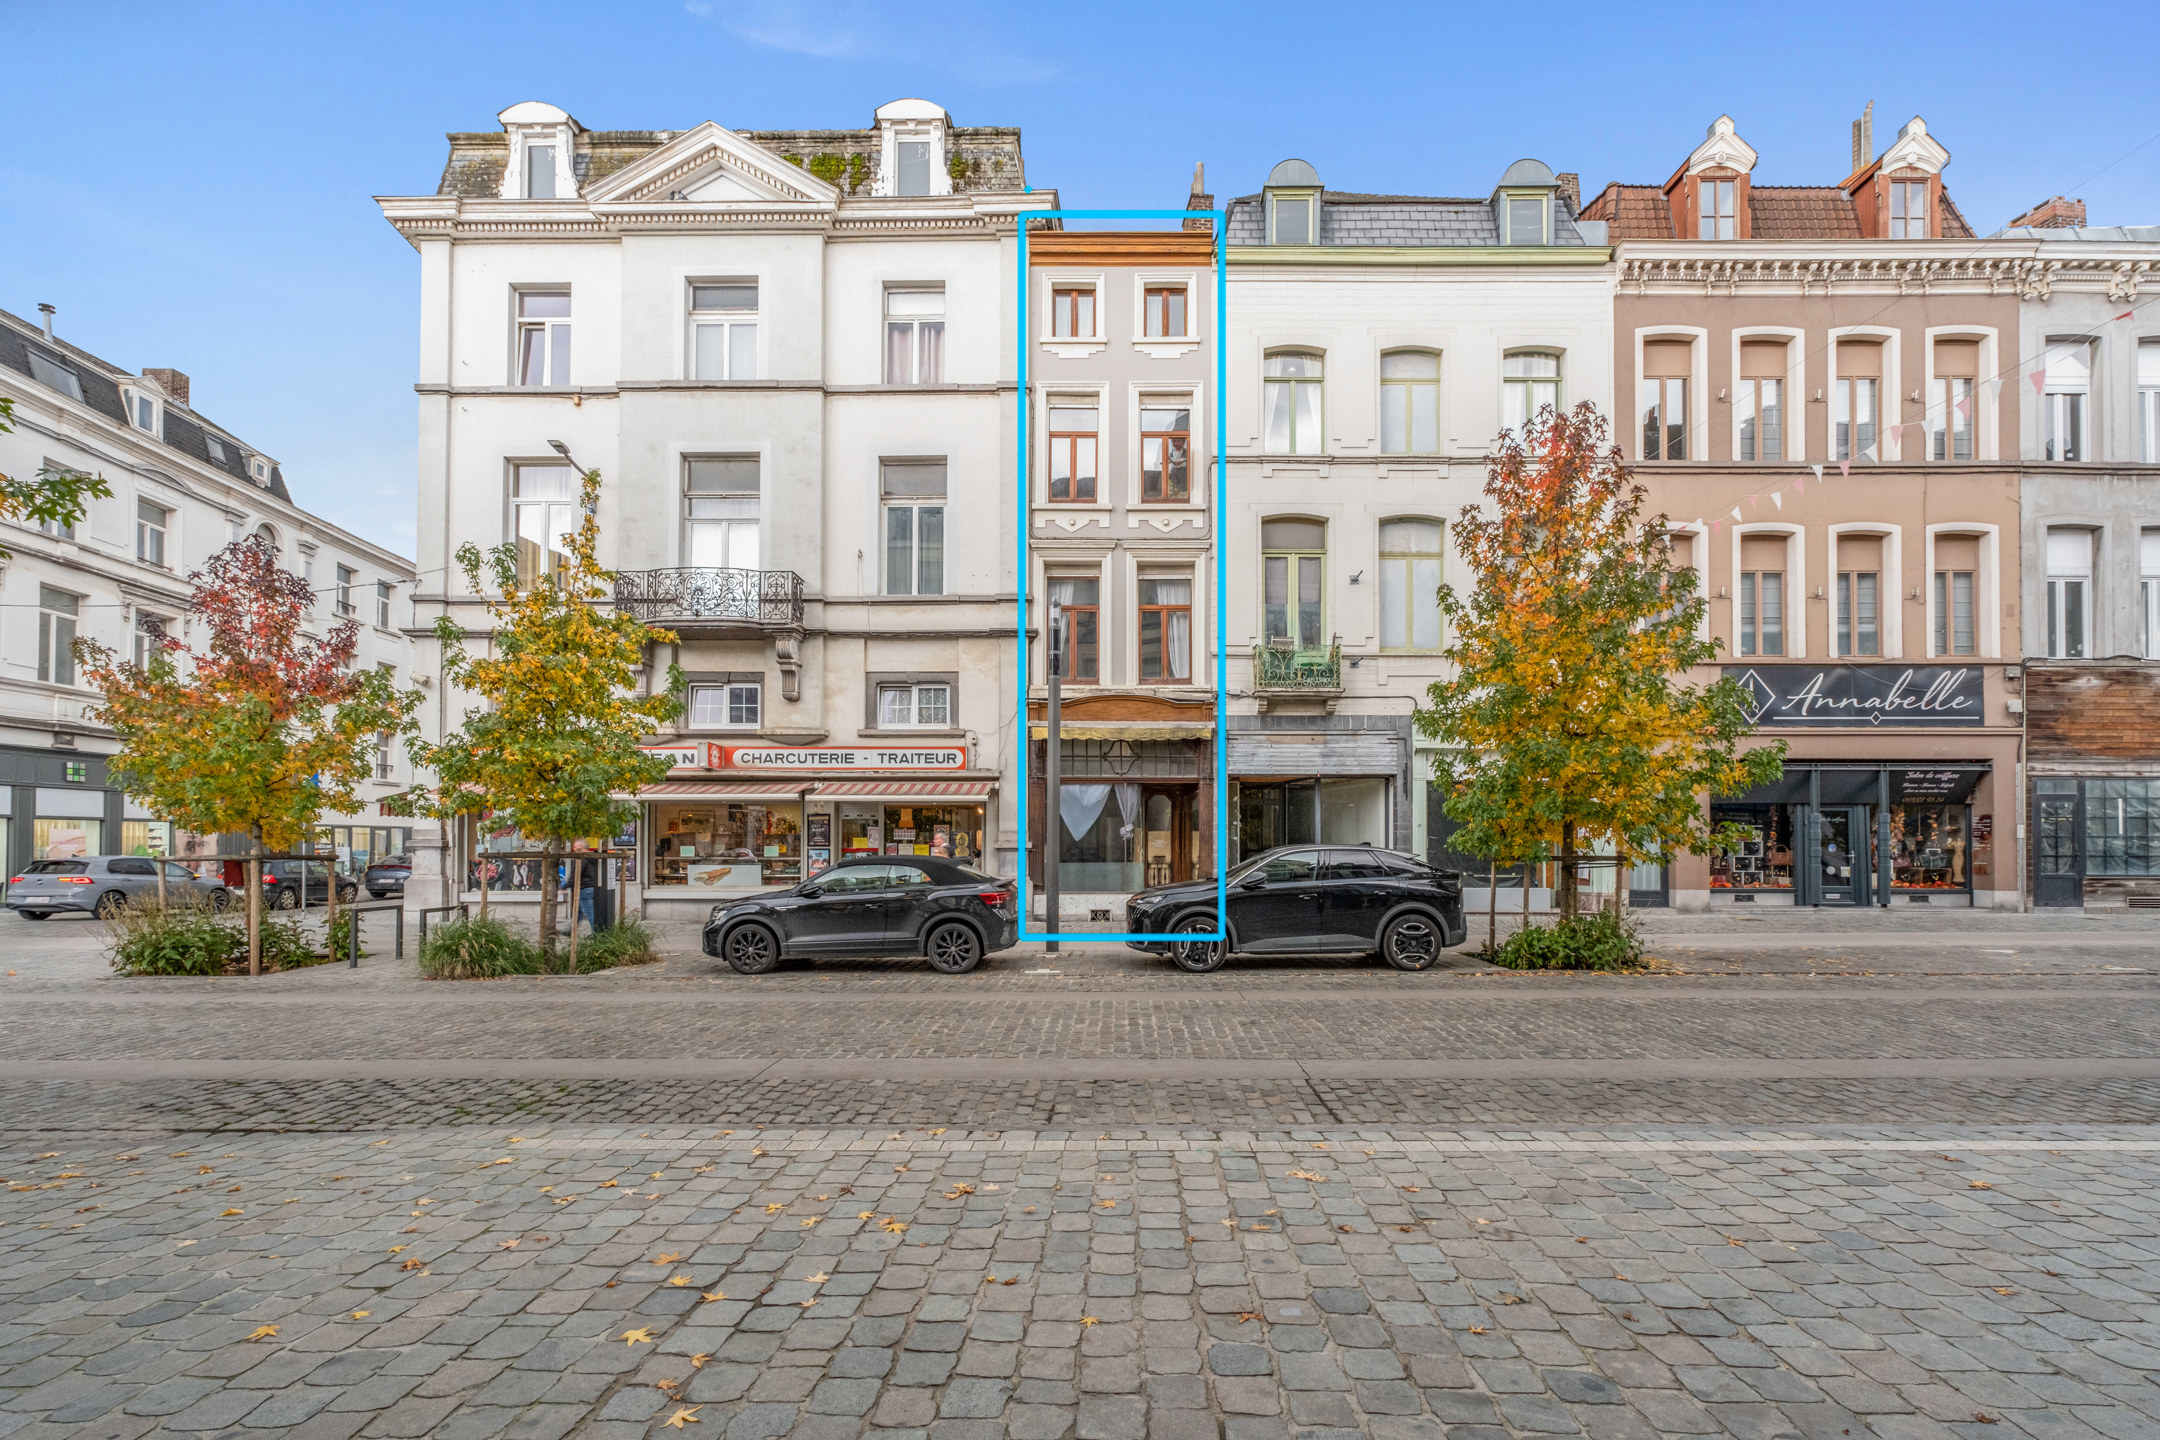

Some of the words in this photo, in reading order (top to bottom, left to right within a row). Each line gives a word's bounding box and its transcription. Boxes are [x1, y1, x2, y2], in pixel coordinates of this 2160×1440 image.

[1782, 668, 1973, 715] Annabelle
[741, 753, 854, 764] CHARCUTERIE
[877, 753, 957, 764] TRAITEUR
